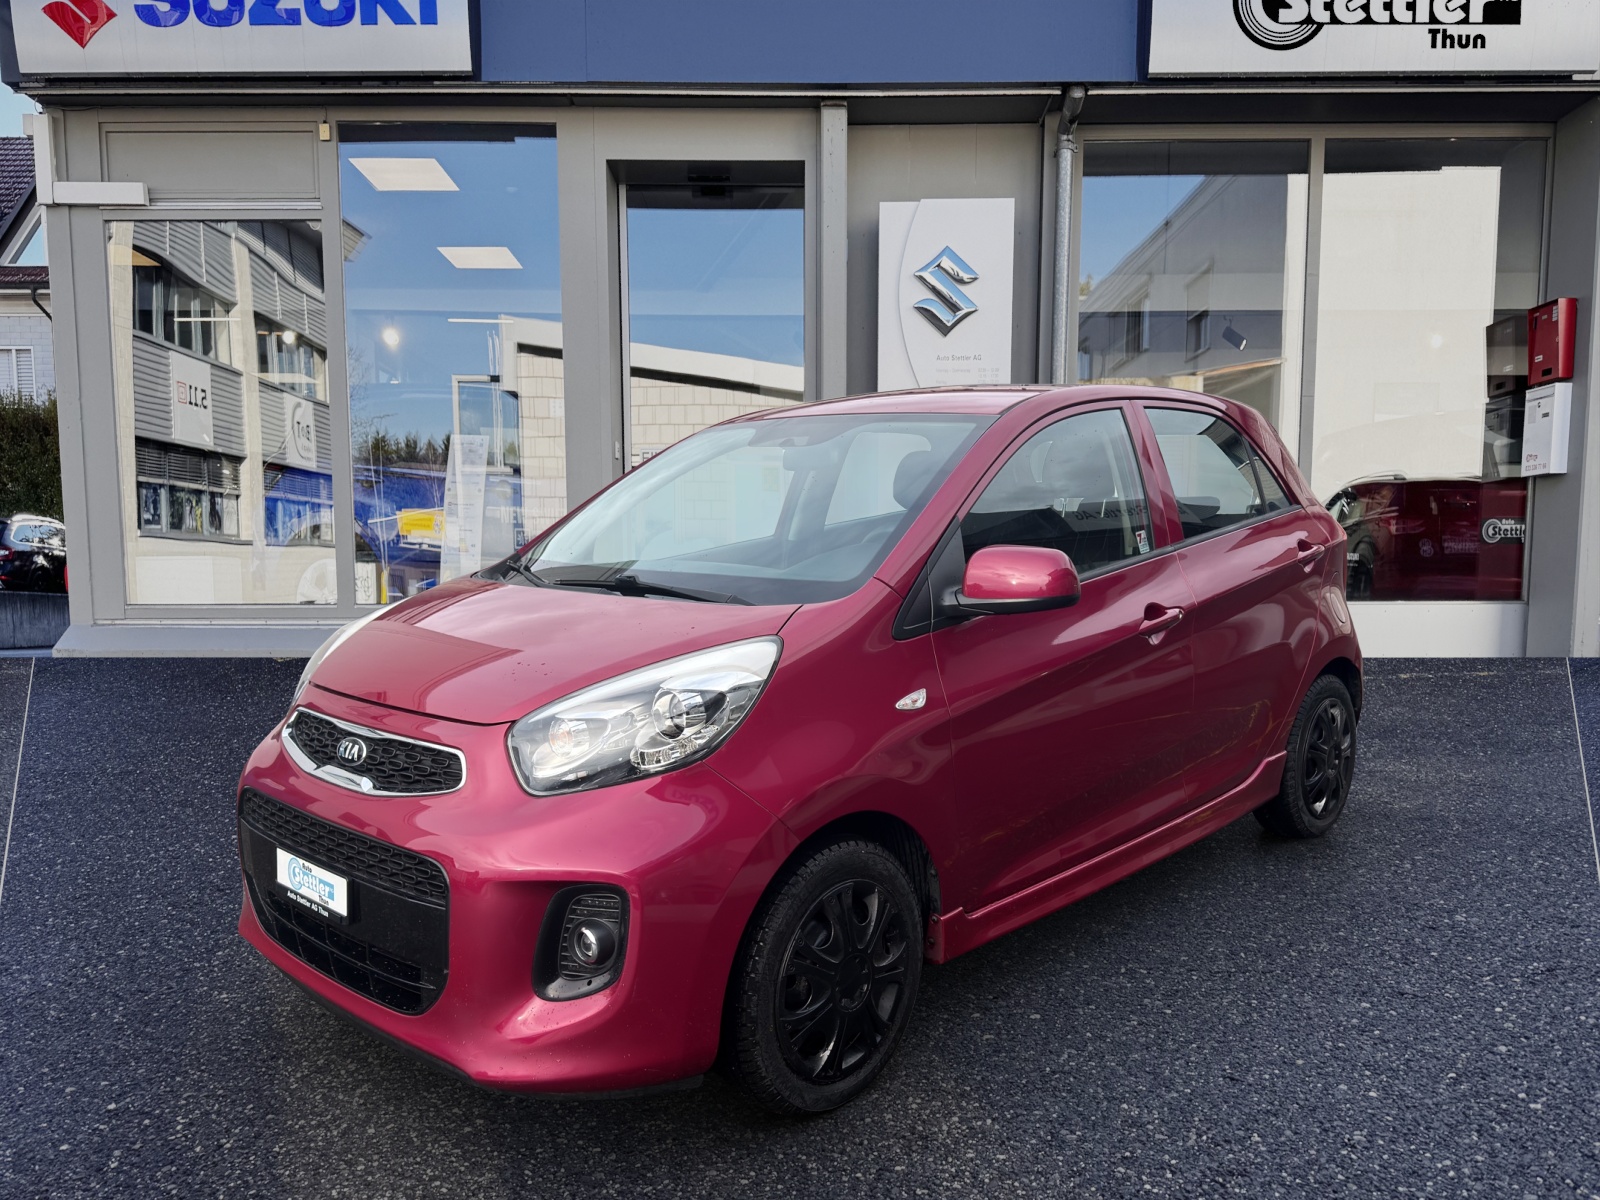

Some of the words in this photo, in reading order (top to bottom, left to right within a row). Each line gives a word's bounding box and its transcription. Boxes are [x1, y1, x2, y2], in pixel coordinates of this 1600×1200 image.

[1428, 28, 1486, 49] Thun
[339, 740, 359, 761] KIA
[302, 862, 312, 873] Auto
[293, 867, 330, 898] Stettler
[287, 890, 297, 901] Auto
[318, 906, 329, 918] Thun
[318, 895, 329, 906] Thun
